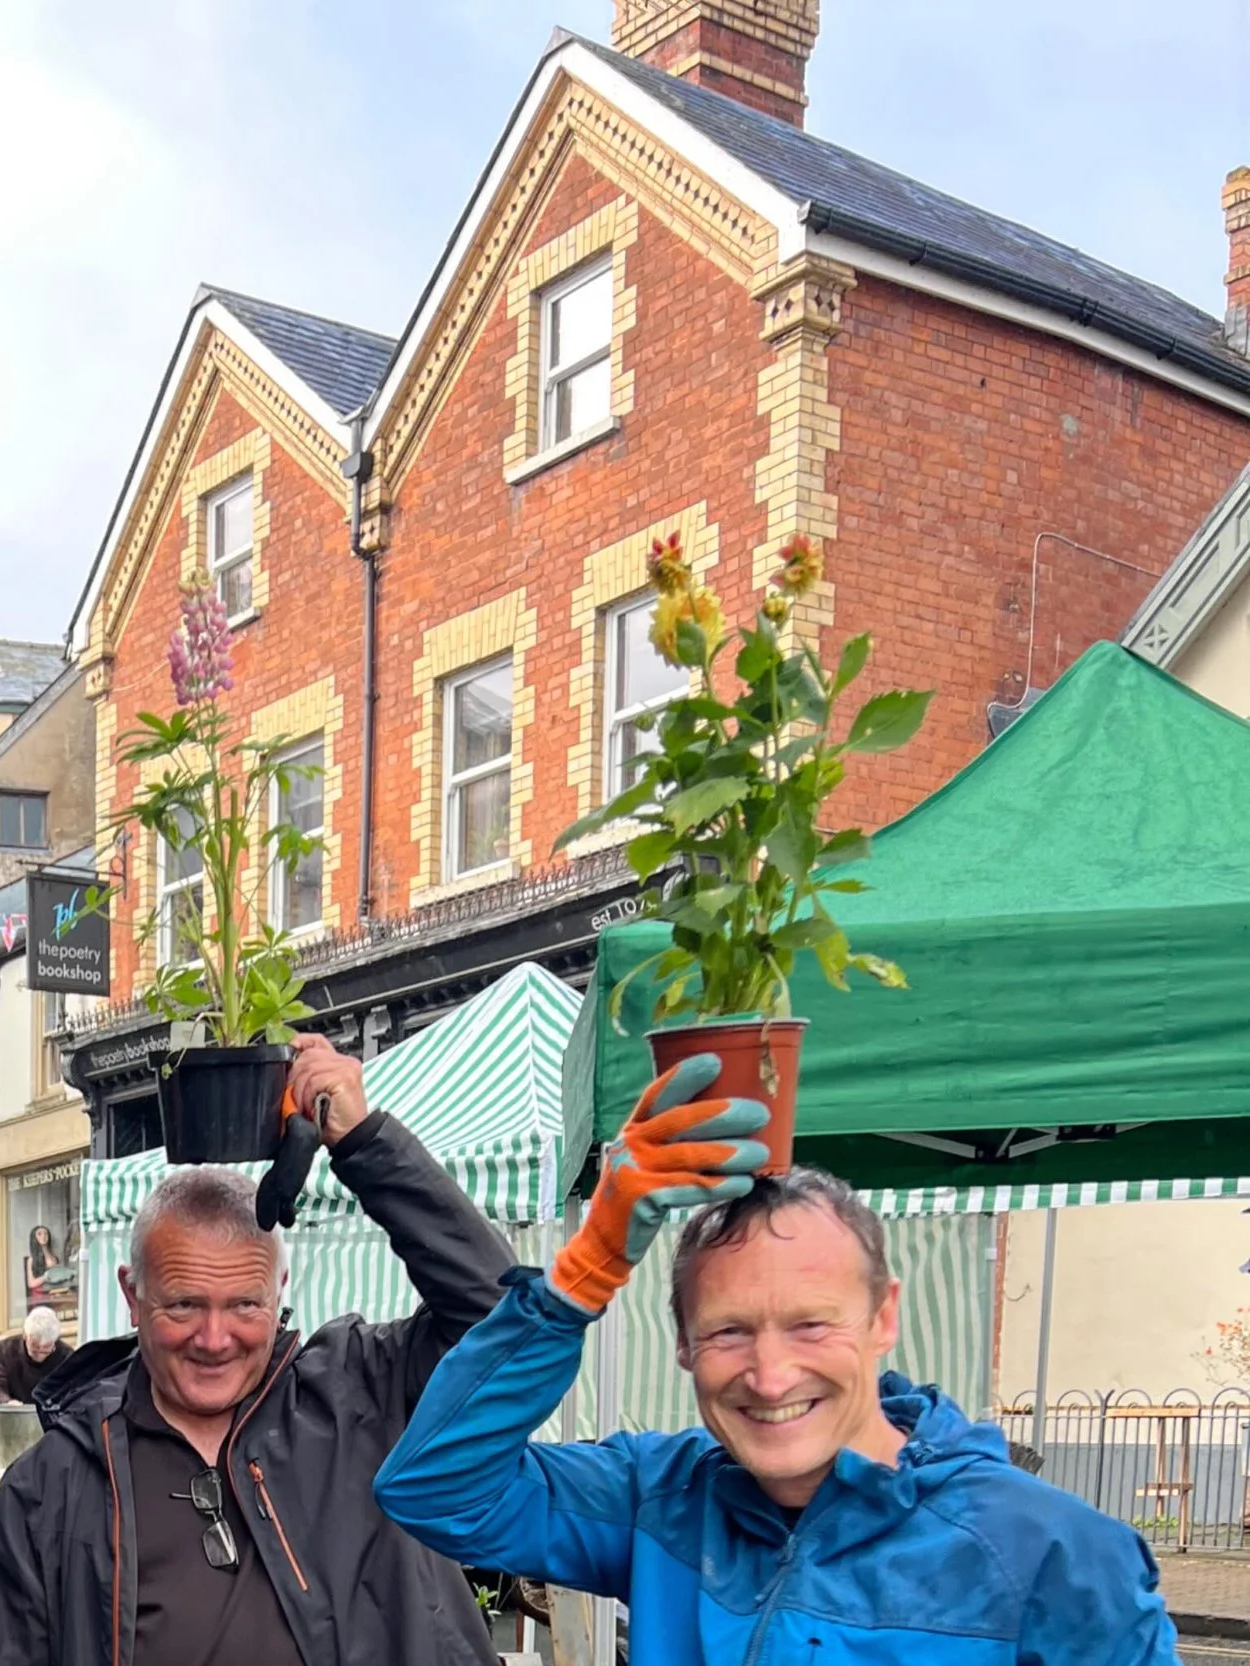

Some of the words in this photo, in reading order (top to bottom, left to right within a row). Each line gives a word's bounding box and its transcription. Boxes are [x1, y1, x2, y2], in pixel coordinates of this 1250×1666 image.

[591, 908, 611, 931] est
[38, 939, 101, 965] thepoetry
[37, 960, 102, 985] bookshop
